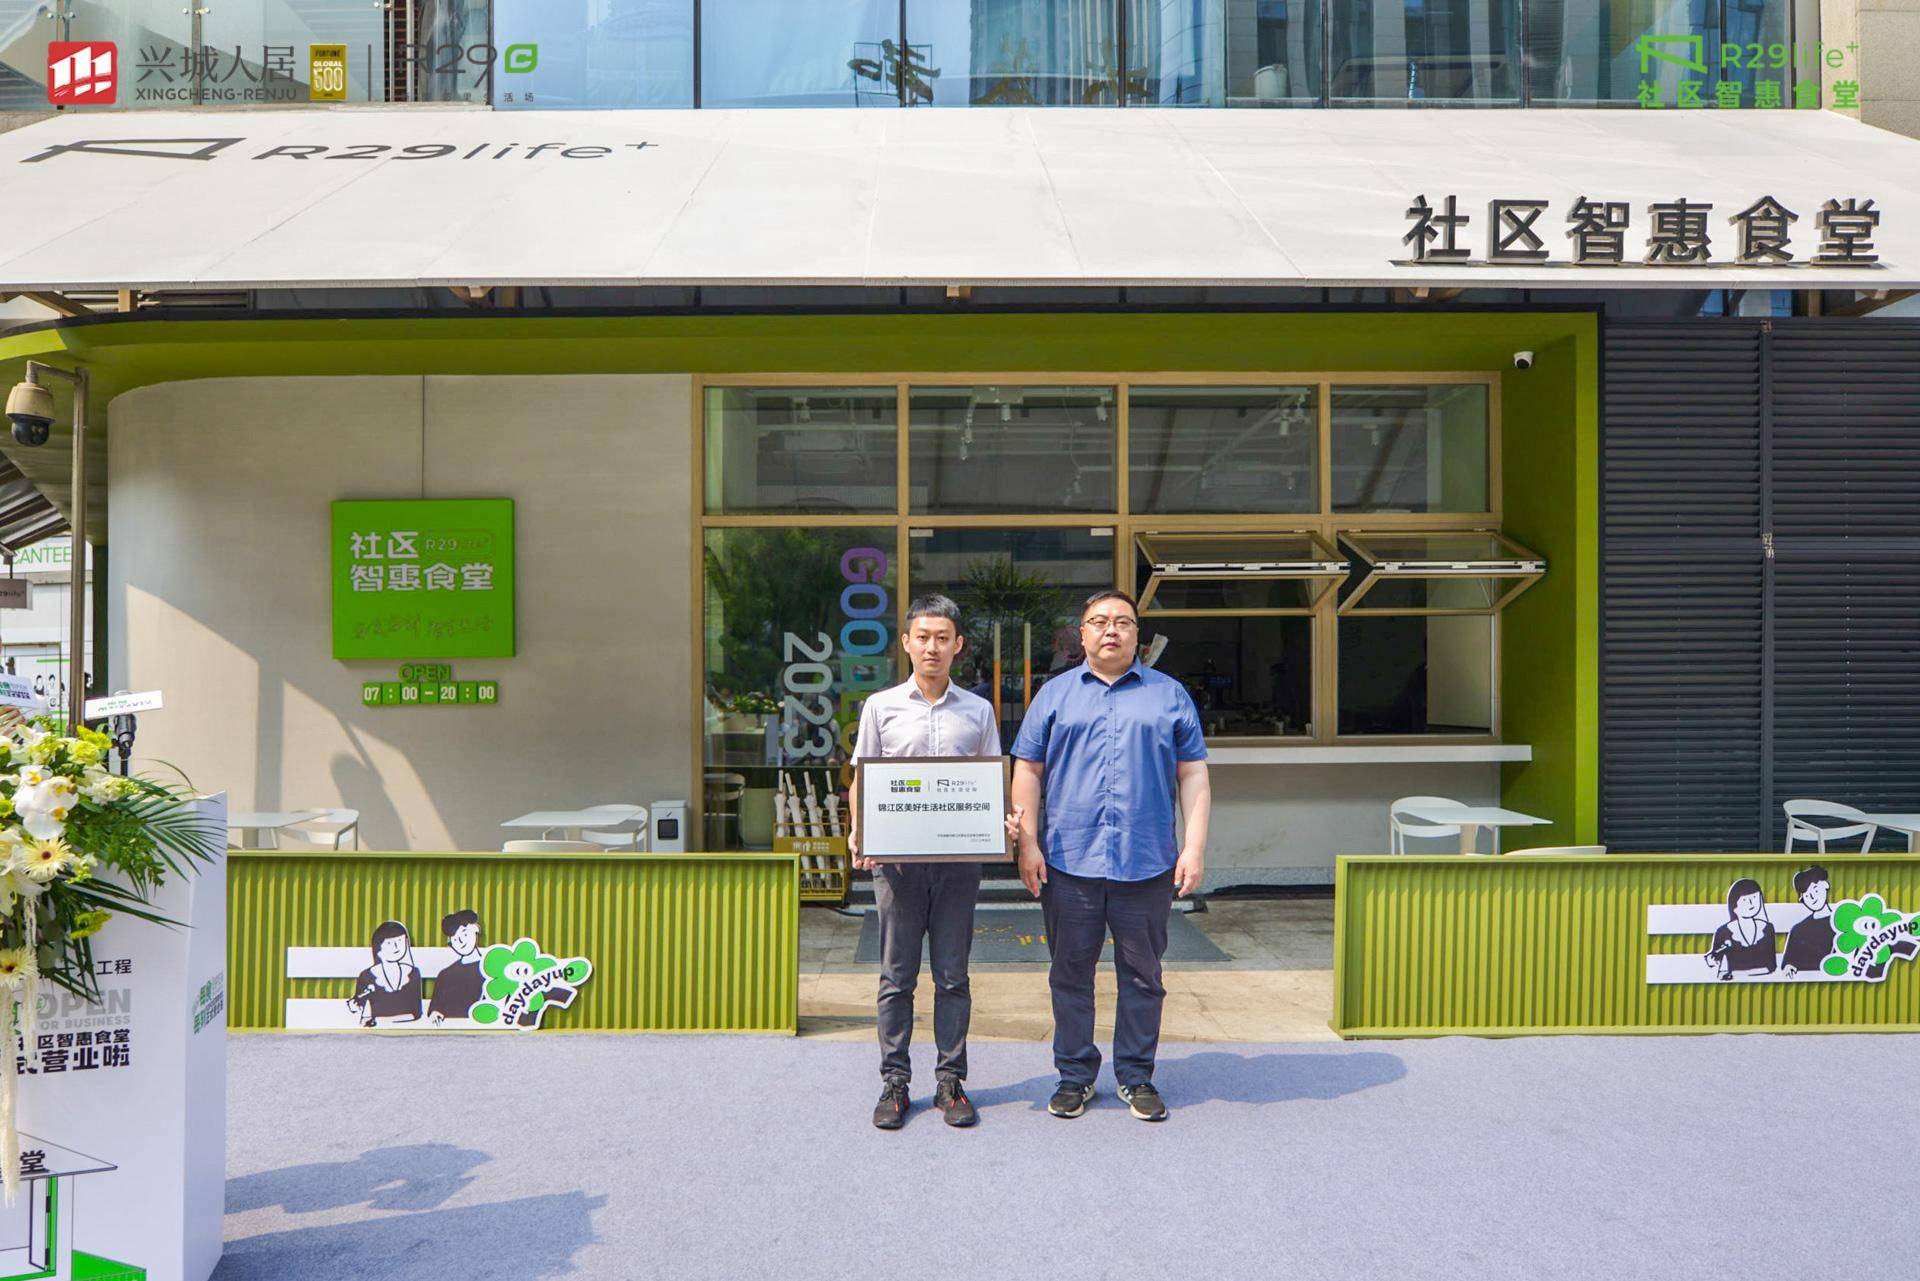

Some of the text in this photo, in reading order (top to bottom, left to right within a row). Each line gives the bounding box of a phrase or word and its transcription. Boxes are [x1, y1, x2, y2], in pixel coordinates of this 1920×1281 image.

[1402, 194, 1882, 265] 社区智惠食堂
[350, 531, 420, 559] 社区
[350, 562, 494, 592] 智惠食堂
[399, 664, 451, 683] OPEN
[783, 631, 834, 758] 2023
[878, 802, 991, 812] 锦江区美好生活社区服务空间
[1851, 920, 1919, 977] daydayup
[503, 966, 575, 1026] daydayup
[64, 1015, 131, 1029] BUSINESS
